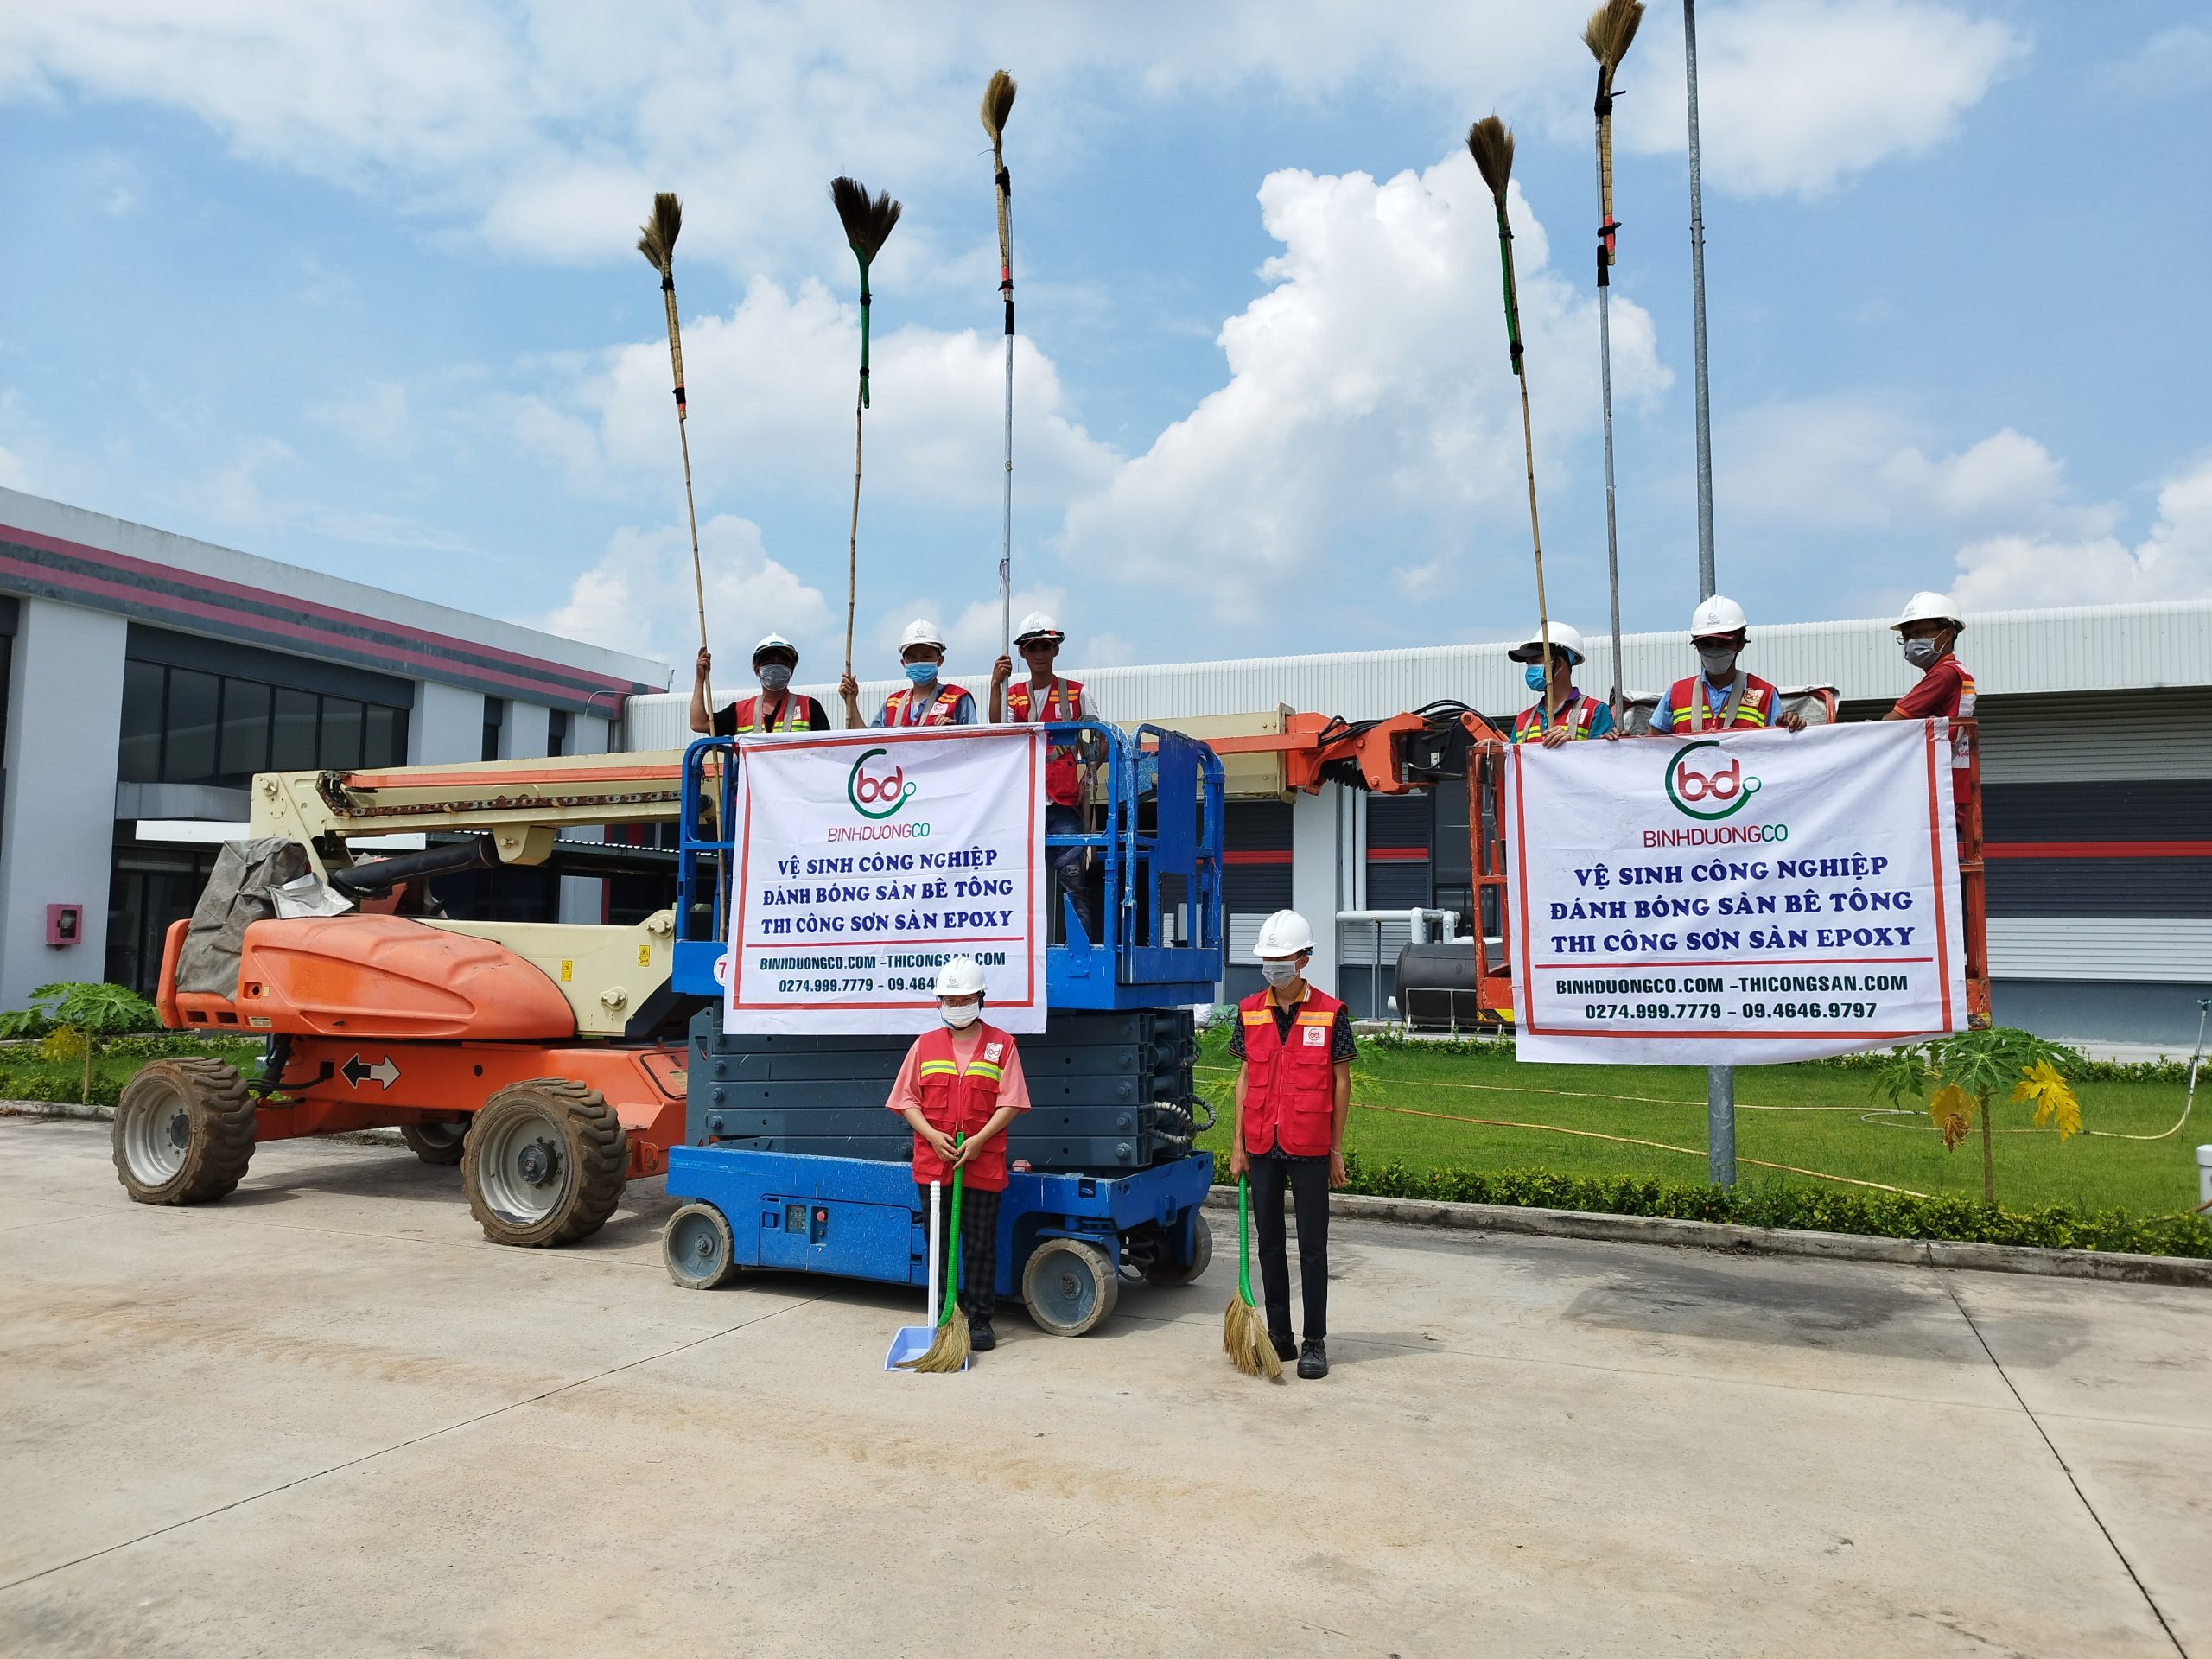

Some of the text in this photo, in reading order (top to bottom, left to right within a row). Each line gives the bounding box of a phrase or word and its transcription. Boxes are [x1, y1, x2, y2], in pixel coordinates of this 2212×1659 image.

[827, 822, 931, 842] BINHDUONGCO
[1643, 823, 1789, 849] BINHDUONGCO
[778, 845, 998, 880] VỆ SINH CÔNG NGHIỆP
[1573, 851, 1889, 891] VỆ SINH CÔNG NGHIỆP
[762, 875, 1014, 906] ĐÁNH BÓNG SÀN BÊ TÔNG
[1549, 887, 1914, 920] ĐÁNH BÓNG SÀN BÊ TÔNG
[761, 908, 1014, 935] THI CÔNG SƠN SÀN EPOXY
[1551, 925, 1916, 953] THI CÔNG SƠN SÀN EPOXY
[760, 956, 876, 970] BINHDUONGCO.COM
[779, 978, 874, 992] 0274.999.7779
[887, 976, 938, 991] 09.464
[1555, 977, 1725, 995] BINHDUONGCO.COM
[1585, 1003, 1721, 1019] 0274.999.7779
[1742, 1002, 1878, 1019] 09.4646.9797
